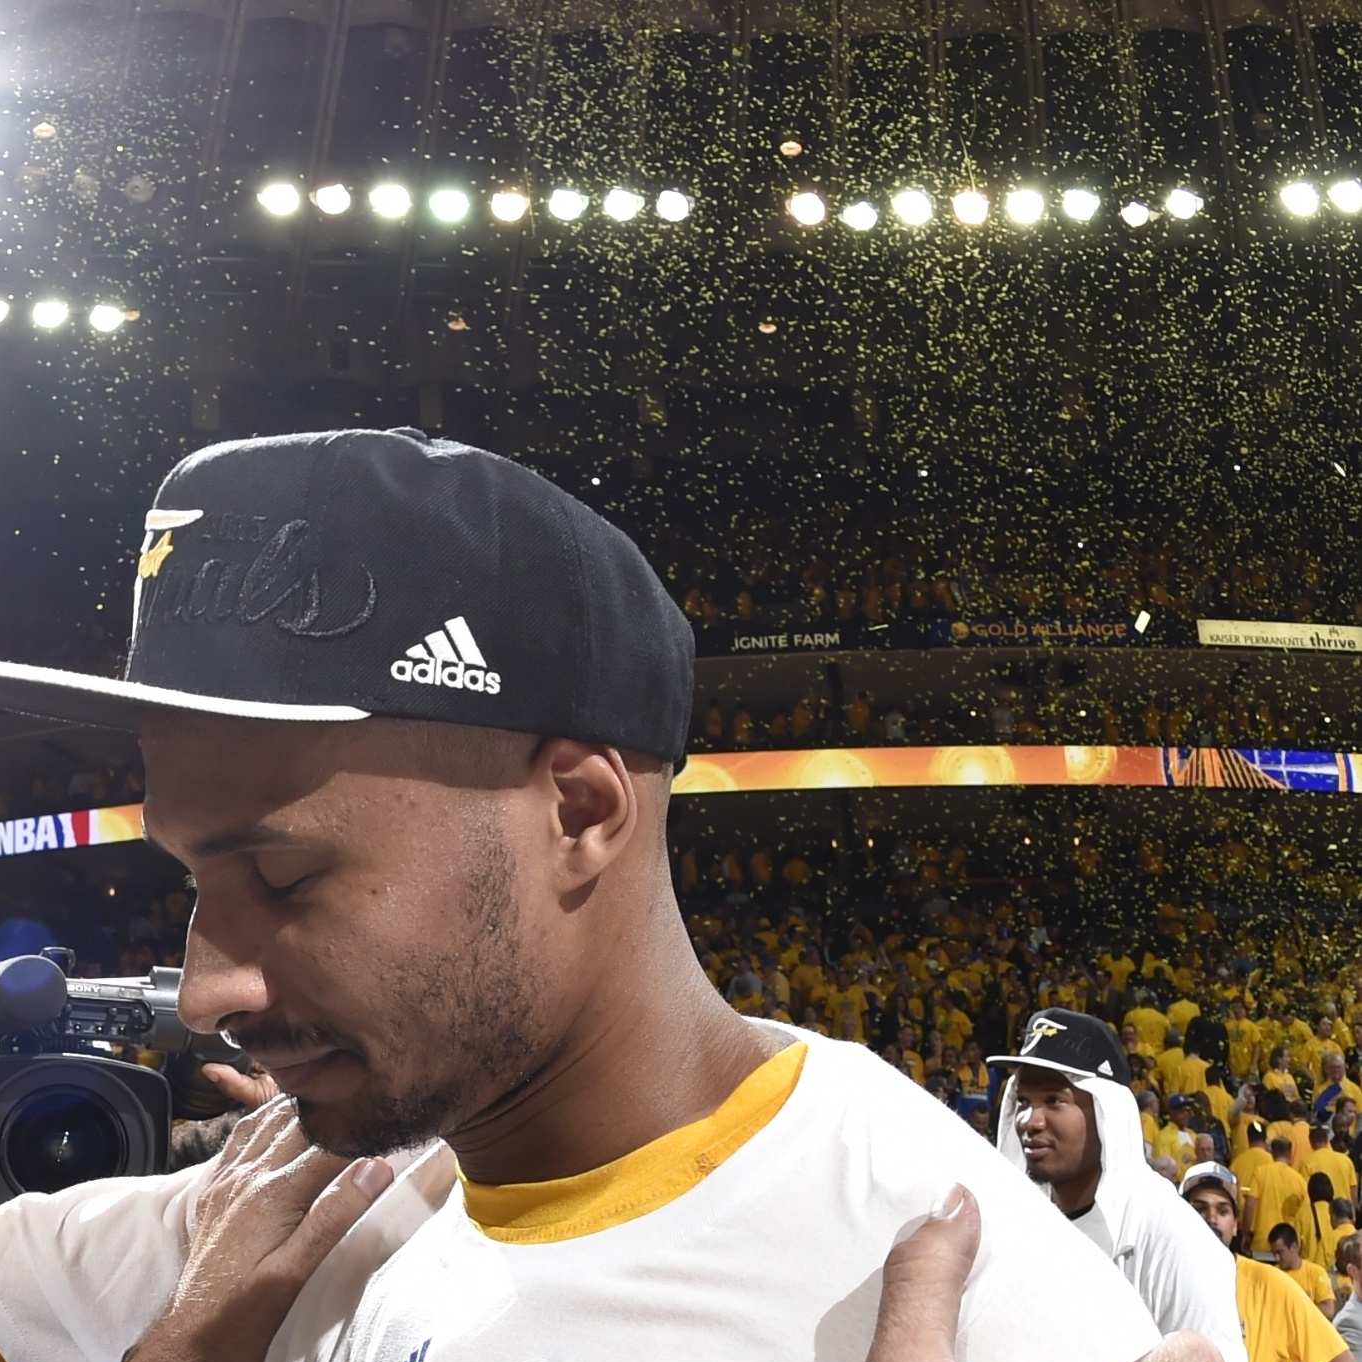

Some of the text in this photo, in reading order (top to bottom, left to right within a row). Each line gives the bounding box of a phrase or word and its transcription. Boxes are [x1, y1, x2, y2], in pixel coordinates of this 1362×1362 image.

[974, 623, 1127, 637] GOLD ALLIANCE
[734, 633, 840, 649] IGNITE FARM
[1209, 634, 1305, 646] KAISER PERMANENTE
[1309, 632, 1357, 649] thrive
[390, 658, 501, 694] adidas
[66, 983, 100, 993] SONY
